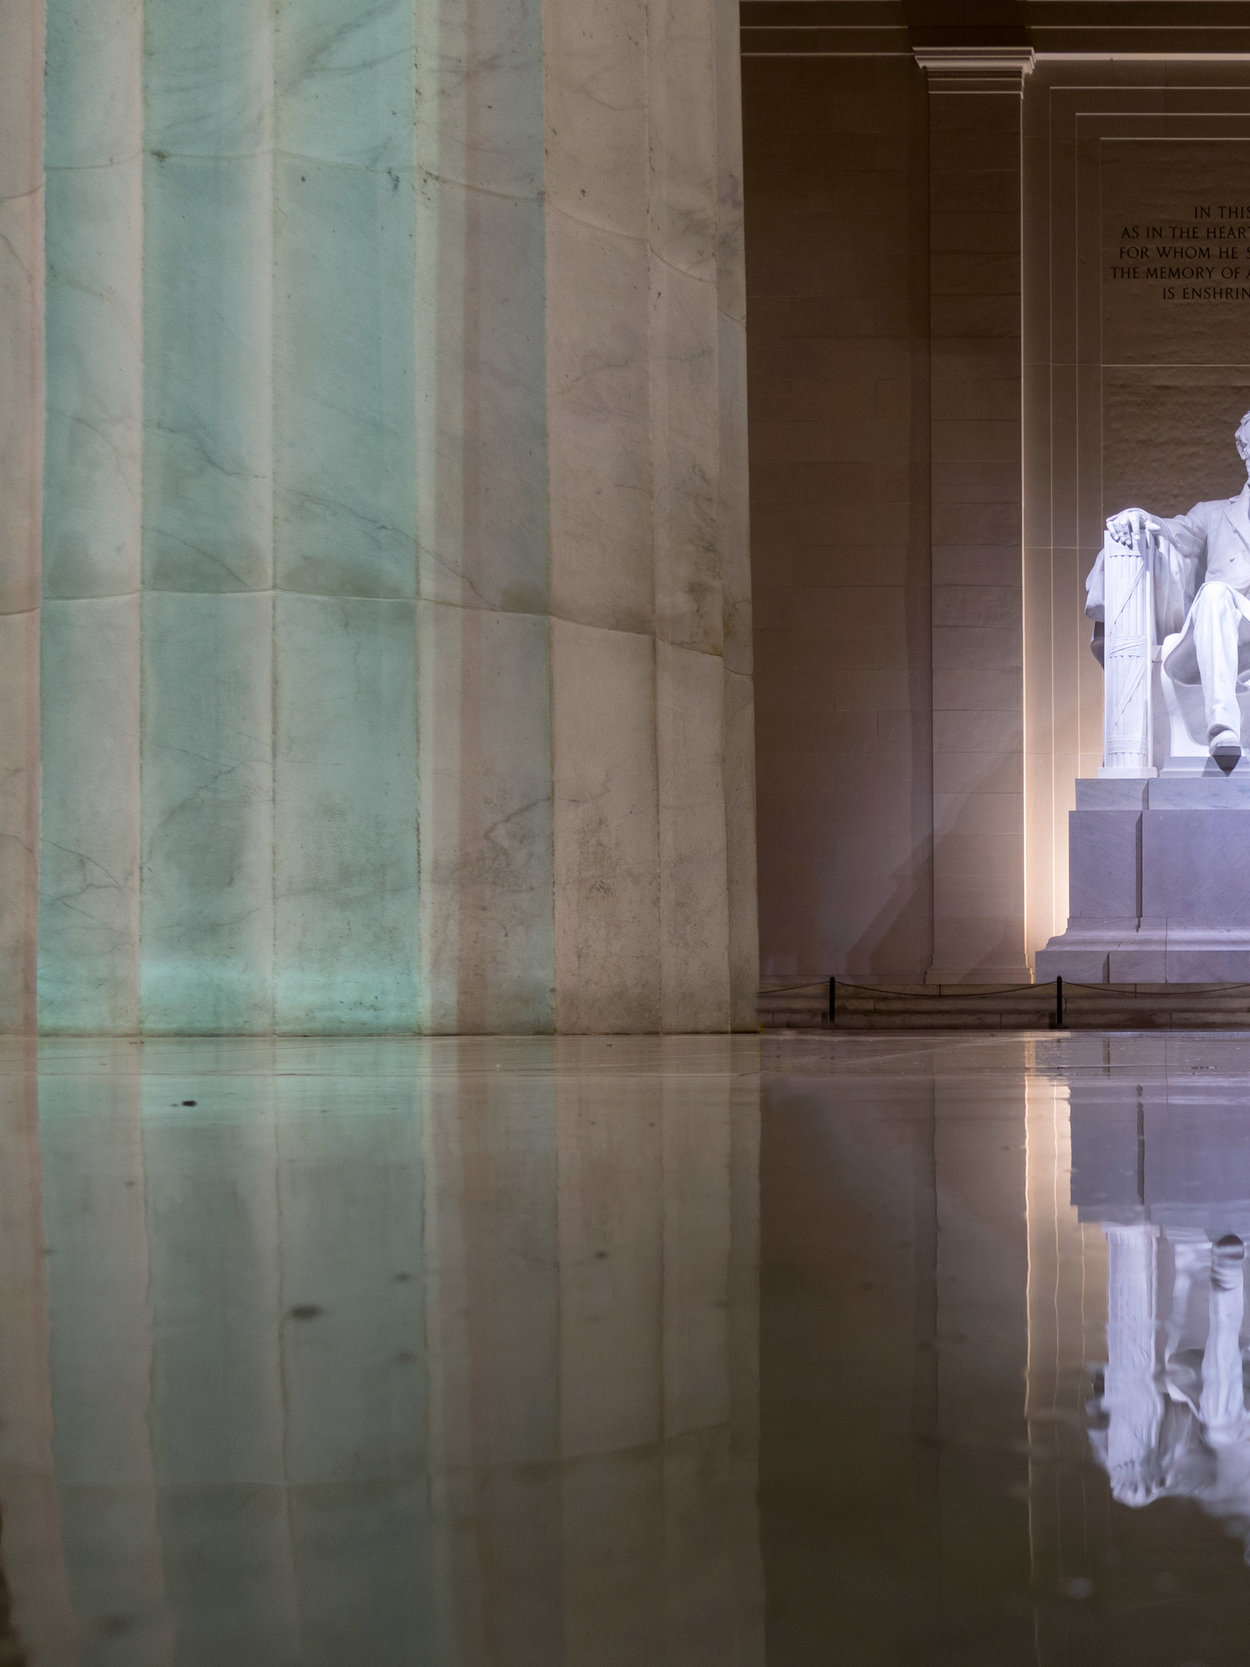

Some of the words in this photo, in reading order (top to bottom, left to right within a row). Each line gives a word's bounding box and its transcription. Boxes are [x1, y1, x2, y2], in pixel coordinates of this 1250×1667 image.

[1195, 206, 1210, 218] IN
[1122, 225, 1139, 239] AS
[1146, 226, 1162, 239] IN
[1169, 226, 1199, 239] THE
[1120, 247, 1149, 259] FOR
[1156, 247, 1210, 259] WHOM
[1219, 247, 1238, 259] HE
[1110, 266, 1139, 279] THE
[1145, 266, 1215, 279] MEMORY
[1221, 267, 1240, 279] OF
[1163, 287, 1175, 299] IS
